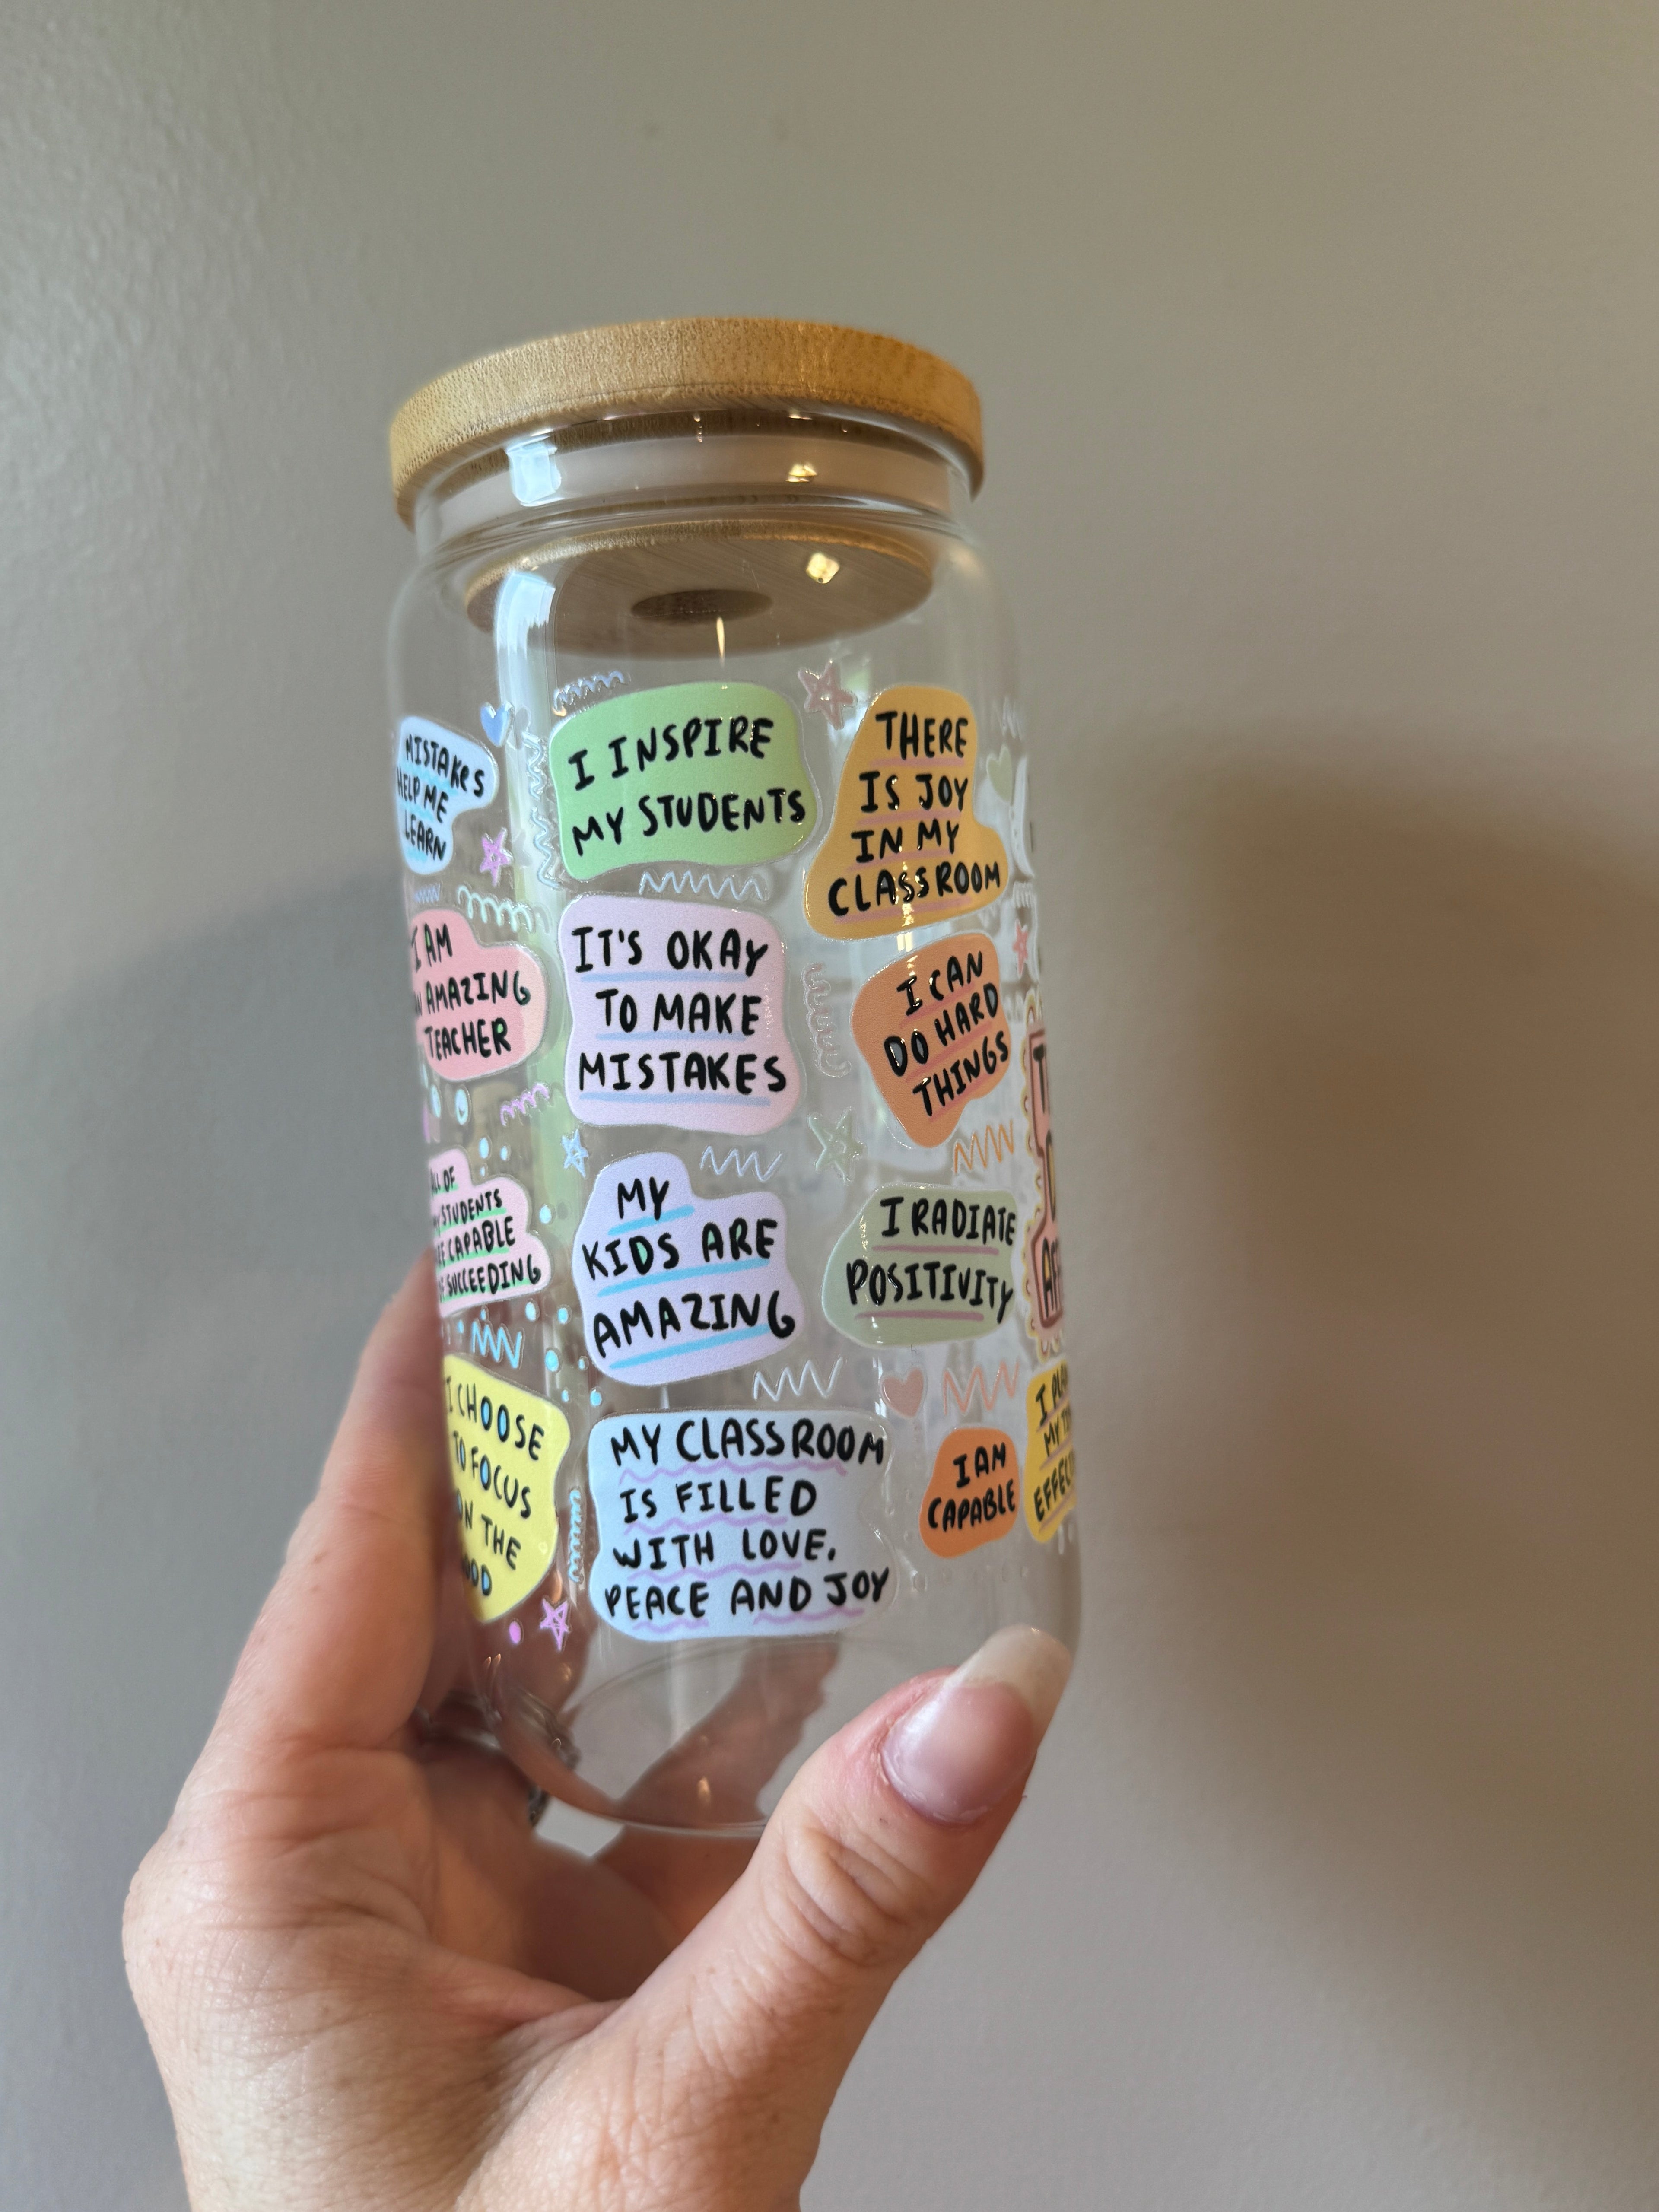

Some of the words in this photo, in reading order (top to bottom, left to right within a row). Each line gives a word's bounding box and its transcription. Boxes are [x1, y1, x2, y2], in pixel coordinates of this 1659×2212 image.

[568, 750, 594, 790] I
[609, 715, 774, 779] INSPIRE
[875, 711, 968, 760] THERE
[397, 767, 420, 803] HELP
[424, 784, 448, 823] ME
[859, 771, 900, 813] IS
[915, 774, 968, 811] JOY
[405, 812, 446, 861] LEARN
[572, 807, 623, 856] MY
[638, 788, 805, 837] STUDENTS
[851, 827, 903, 864] IN
[917, 819, 959, 854] MY
[828, 861, 1000, 916] CLASSROOM
[411, 925, 421, 972] I
[424, 923, 453, 967] AM
[572, 926, 642, 973] IT'S
[667, 928, 768, 977] OKAY
[426, 970, 531, 1014] AMAZING
[896, 974, 923, 1016] I
[928, 951, 982, 1001] CAN
[595, 988, 637, 1033] TO
[653, 992, 761, 1036] MAKE
[884, 1030, 929, 1077] DO
[934, 982, 998, 1047] HARD
[424, 1017, 511, 1061] TEACHER
[579, 1052, 786, 1095] MISTAKES
[912, 1030, 1008, 1116] THINGS
[443, 1166, 455, 1192] OF
[617, 1176, 670, 1221] MY
[441, 1189, 502, 1227] STUDENTS
[880, 1197, 904, 1237] I
[912, 1198, 1015, 1246] RADIATE
[448, 1216, 515, 1261] CAPABLE
[582, 1232, 680, 1281] KIDS
[701, 1217, 778, 1263] ARE
[447, 1254, 541, 1297] SUCCEEDING
[846, 1258, 1013, 1324] POSITIVITY
[593, 1290, 796, 1358] AMAZING
[447, 1375, 453, 1413] I
[458, 1382, 544, 1461] CHOOSE
[1036, 1383, 1047, 1426] I
[610, 1424, 661, 1466] MY
[676, 1417, 884, 1465] CLASSROOM
[1044, 1415, 1059, 1458] MY
[453, 1430, 466, 1471] TO
[471, 1446, 531, 1519] FOCUS
[953, 1453, 970, 1488] I
[975, 1442, 1006, 1478] AM
[620, 1488, 657, 1523] IS
[675, 1475, 817, 1516] FILLED
[928, 1478, 1015, 1532] CAPABLE
[481, 1513, 521, 1570] THE
[613, 1531, 714, 1569] WITH
[605, 1581, 709, 1619] PEACE
[731, 1575, 812, 1615] AND
[824, 1567, 889, 1605] JOY
